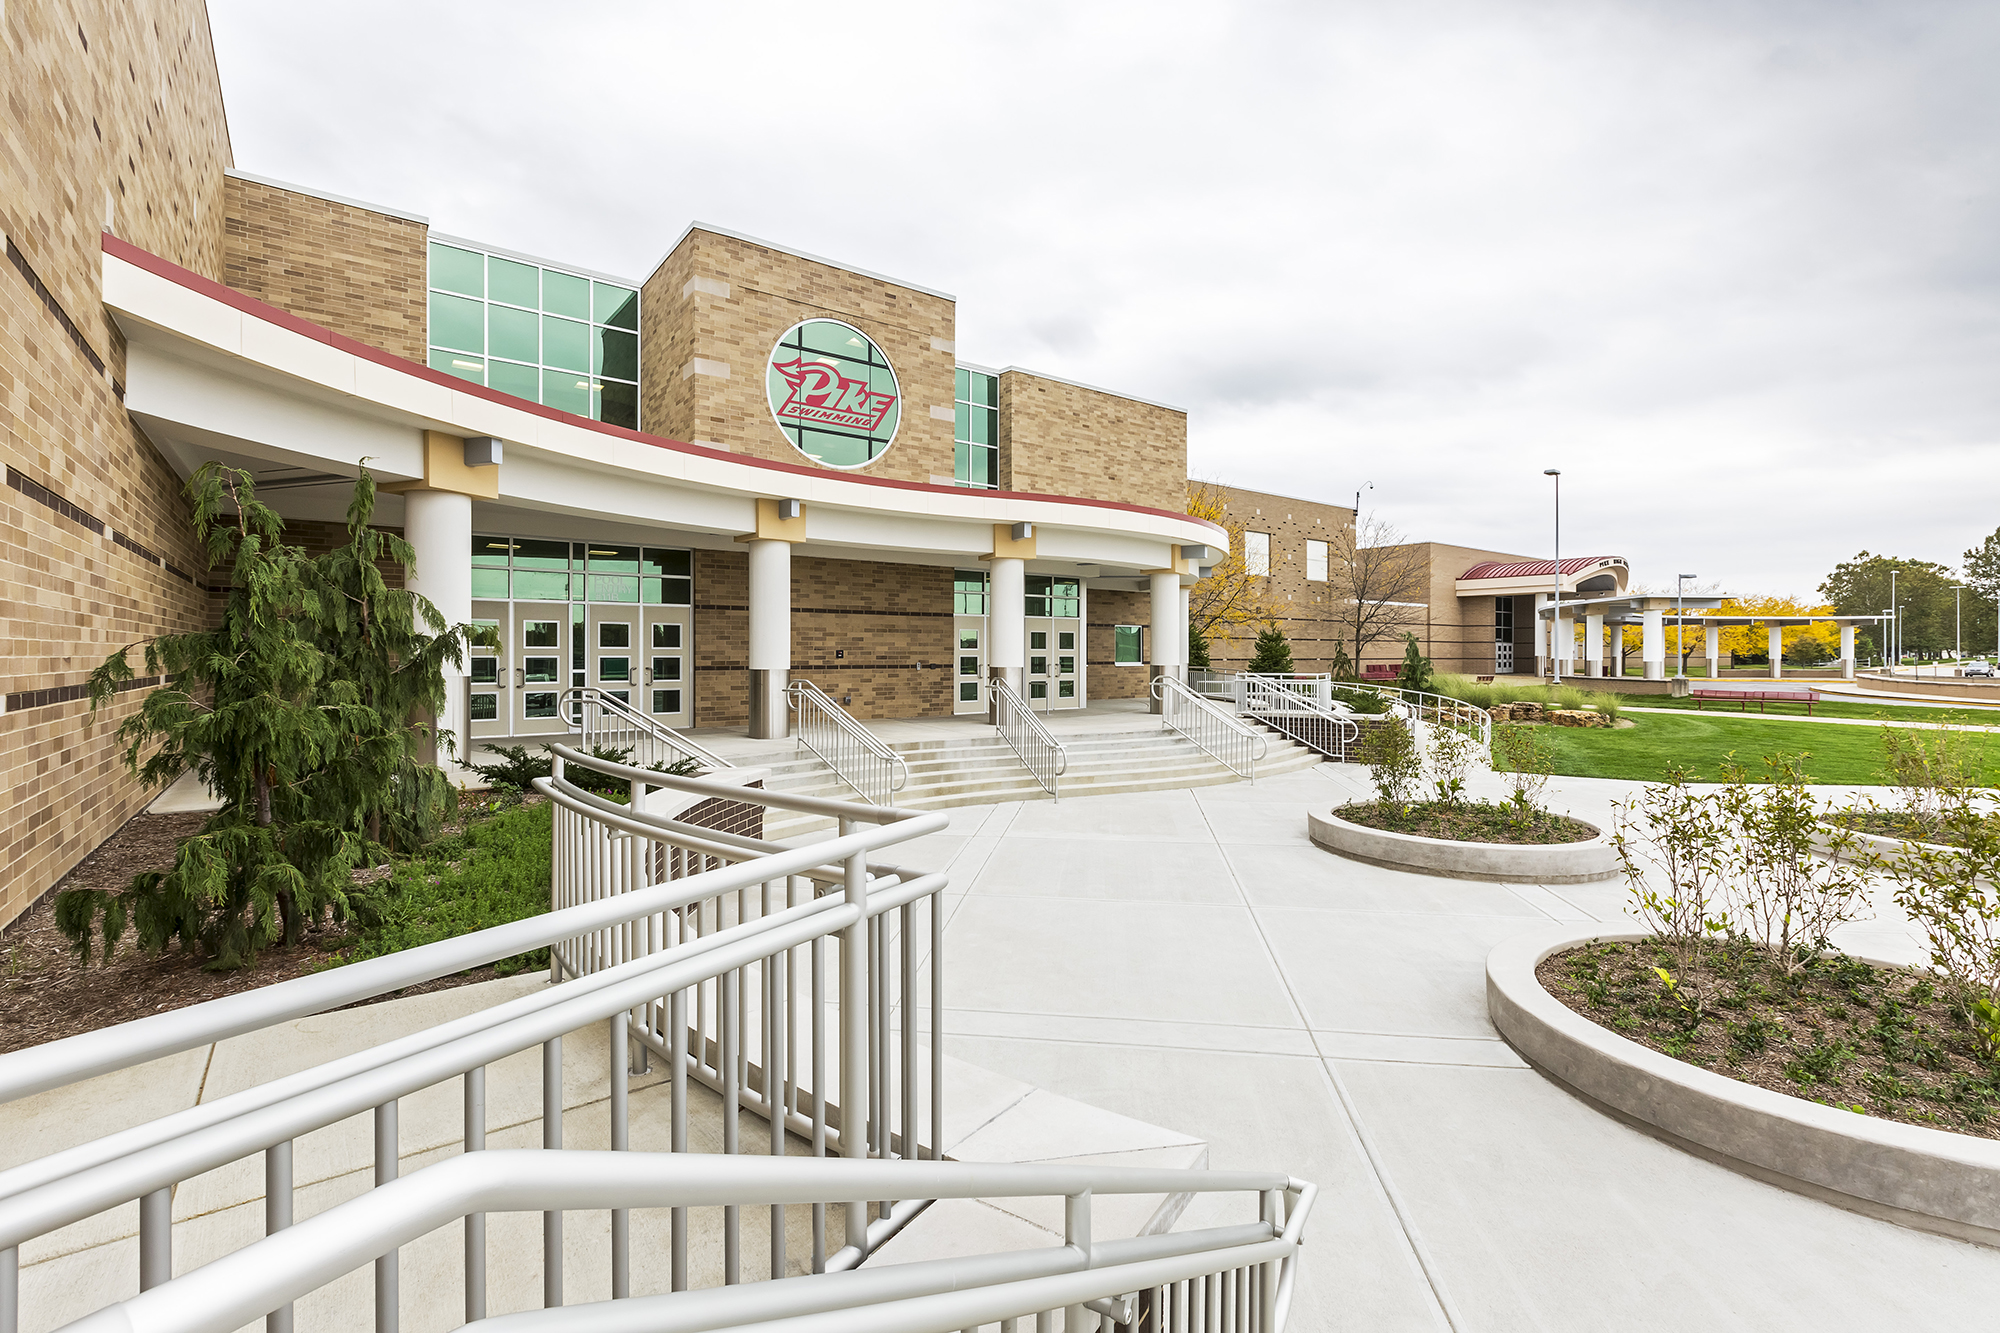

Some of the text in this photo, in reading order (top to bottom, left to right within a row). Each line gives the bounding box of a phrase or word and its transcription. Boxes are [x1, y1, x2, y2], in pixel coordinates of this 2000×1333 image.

[788, 406, 872, 426] SWIMMING
[595, 576, 623, 585] POOL
[595, 584, 631, 594] ENTRY
